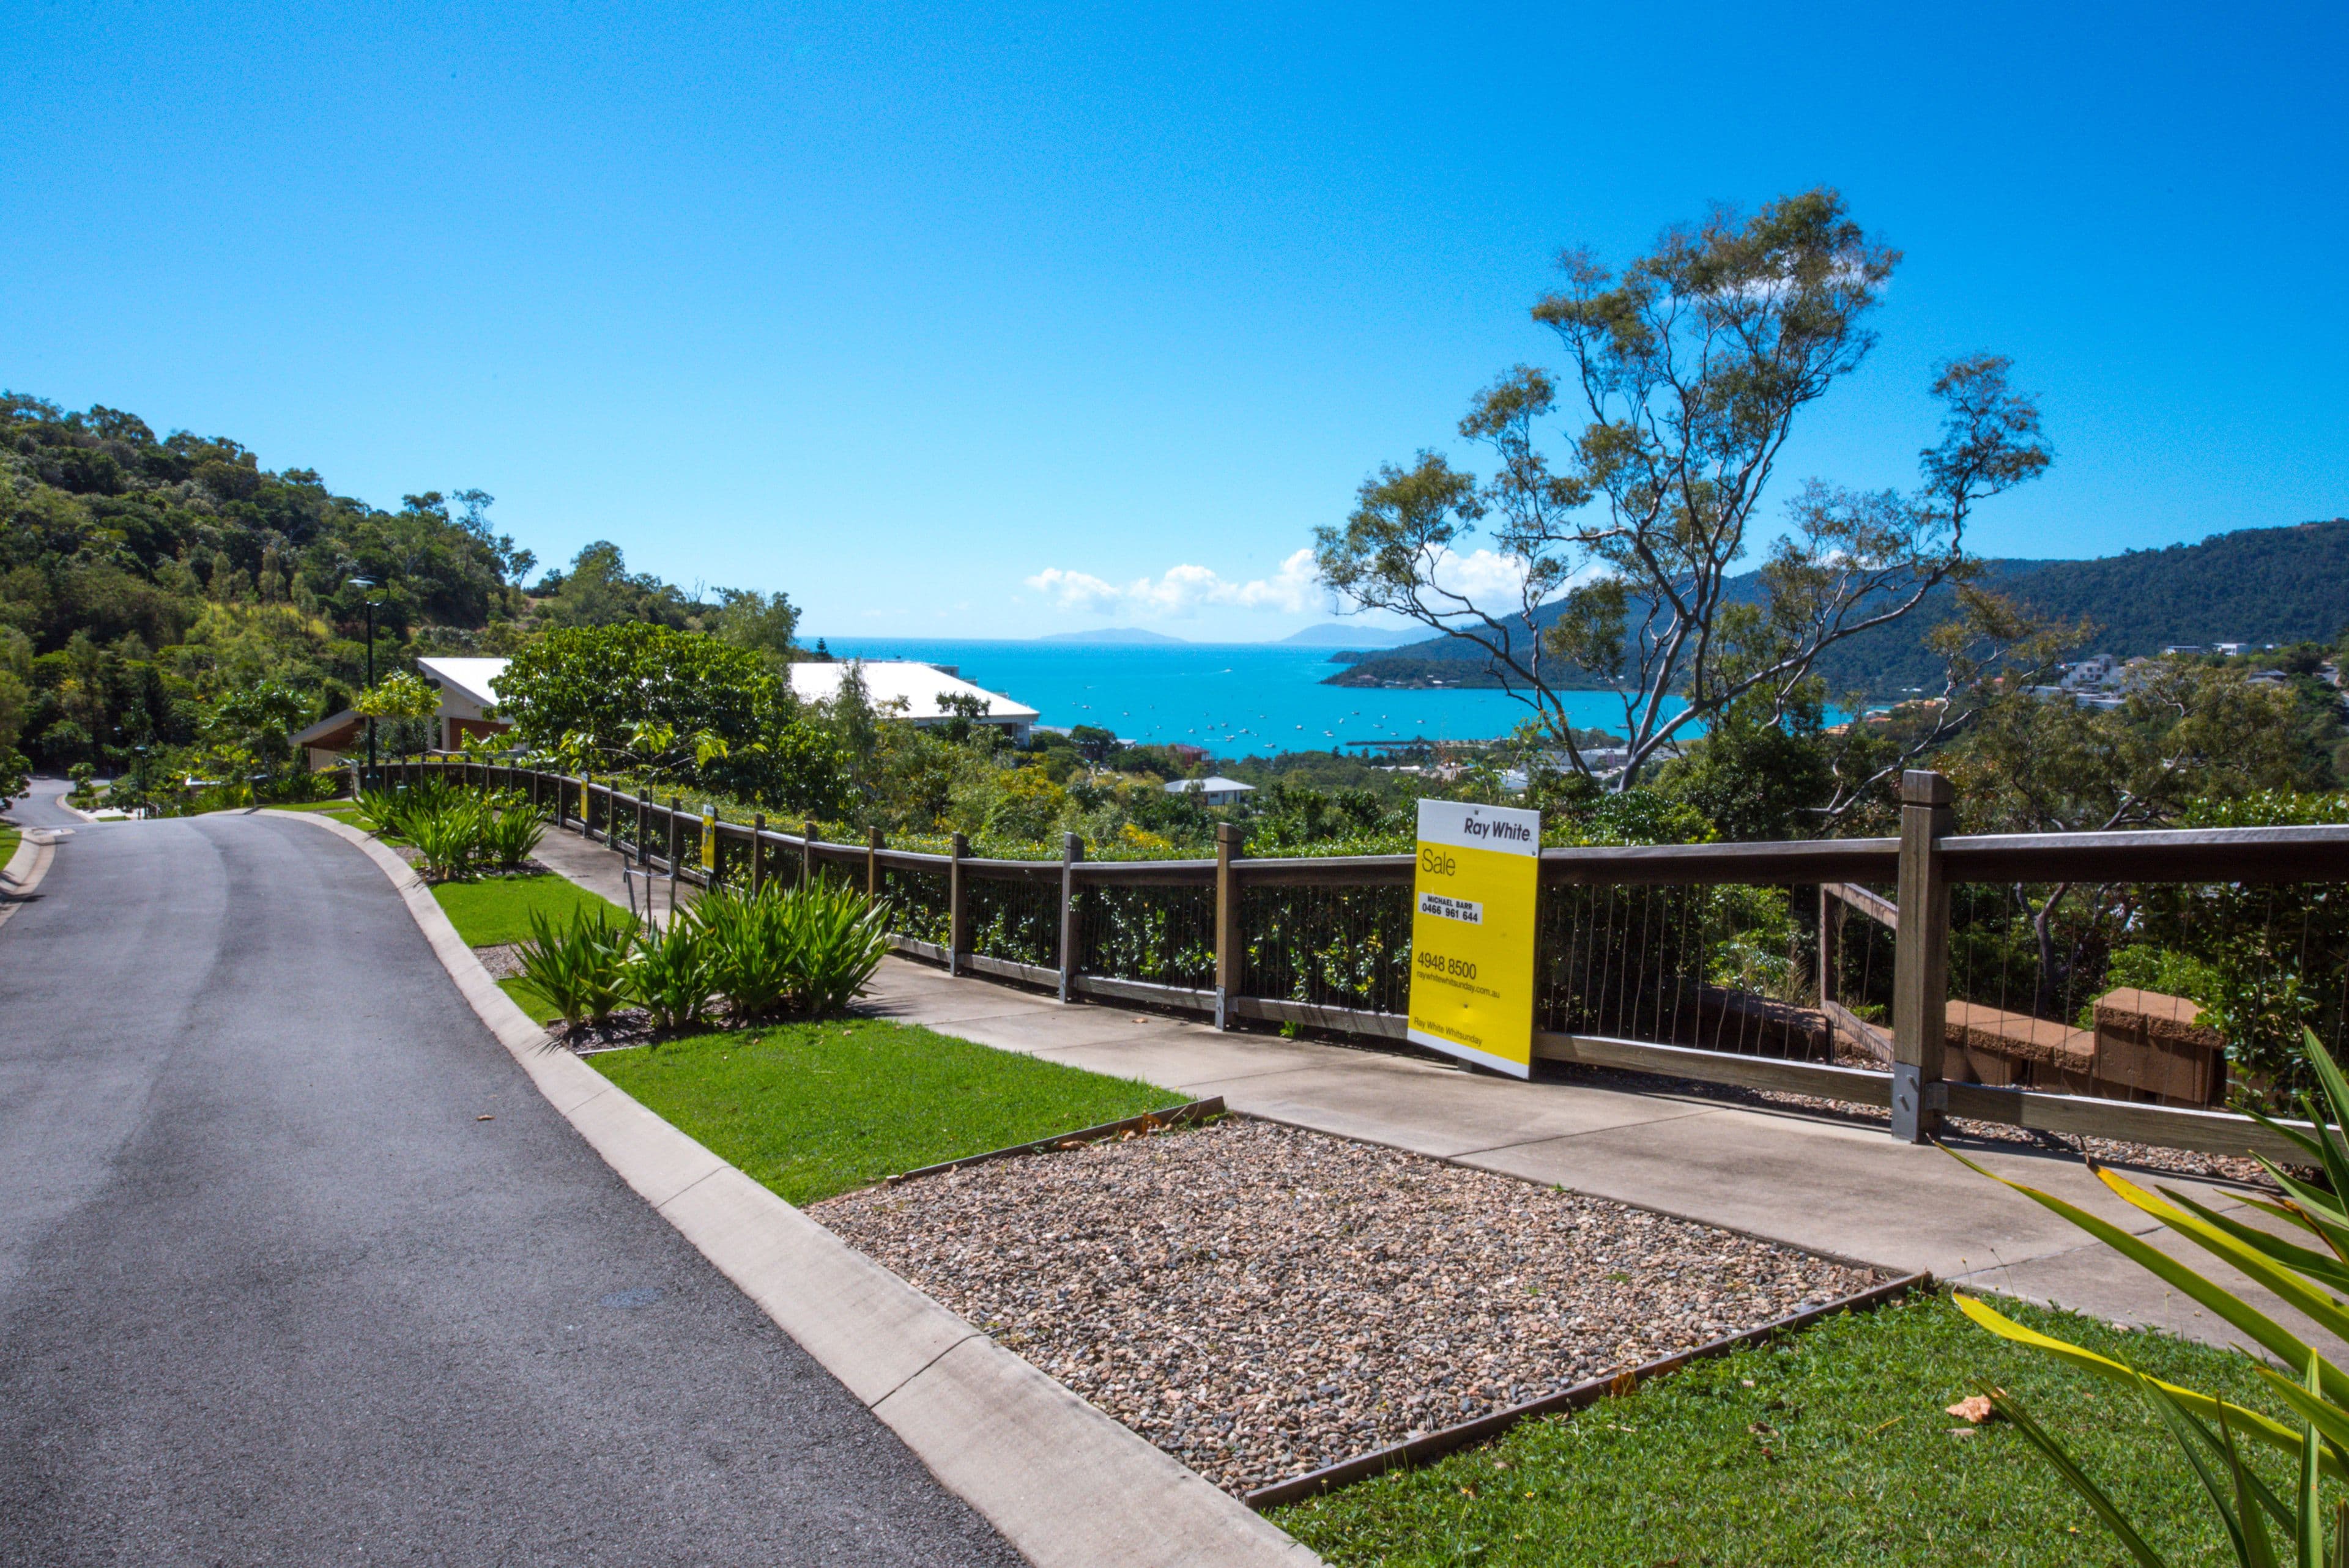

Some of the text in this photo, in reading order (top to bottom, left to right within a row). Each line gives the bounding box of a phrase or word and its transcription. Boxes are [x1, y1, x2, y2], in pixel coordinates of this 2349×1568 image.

[1464, 818, 1490, 839] Ray
[1422, 848, 1455, 876] Sale
[1422, 903, 1478, 922] 0466 961 644
[1456, 901, 1472, 910] BARR
[1417, 952, 1477, 980] 4948 8500
[1417, 971, 1500, 998] raywhitewhitsunday.com.au
[1414, 1017, 1483, 1047] Ray White Whitsunday
